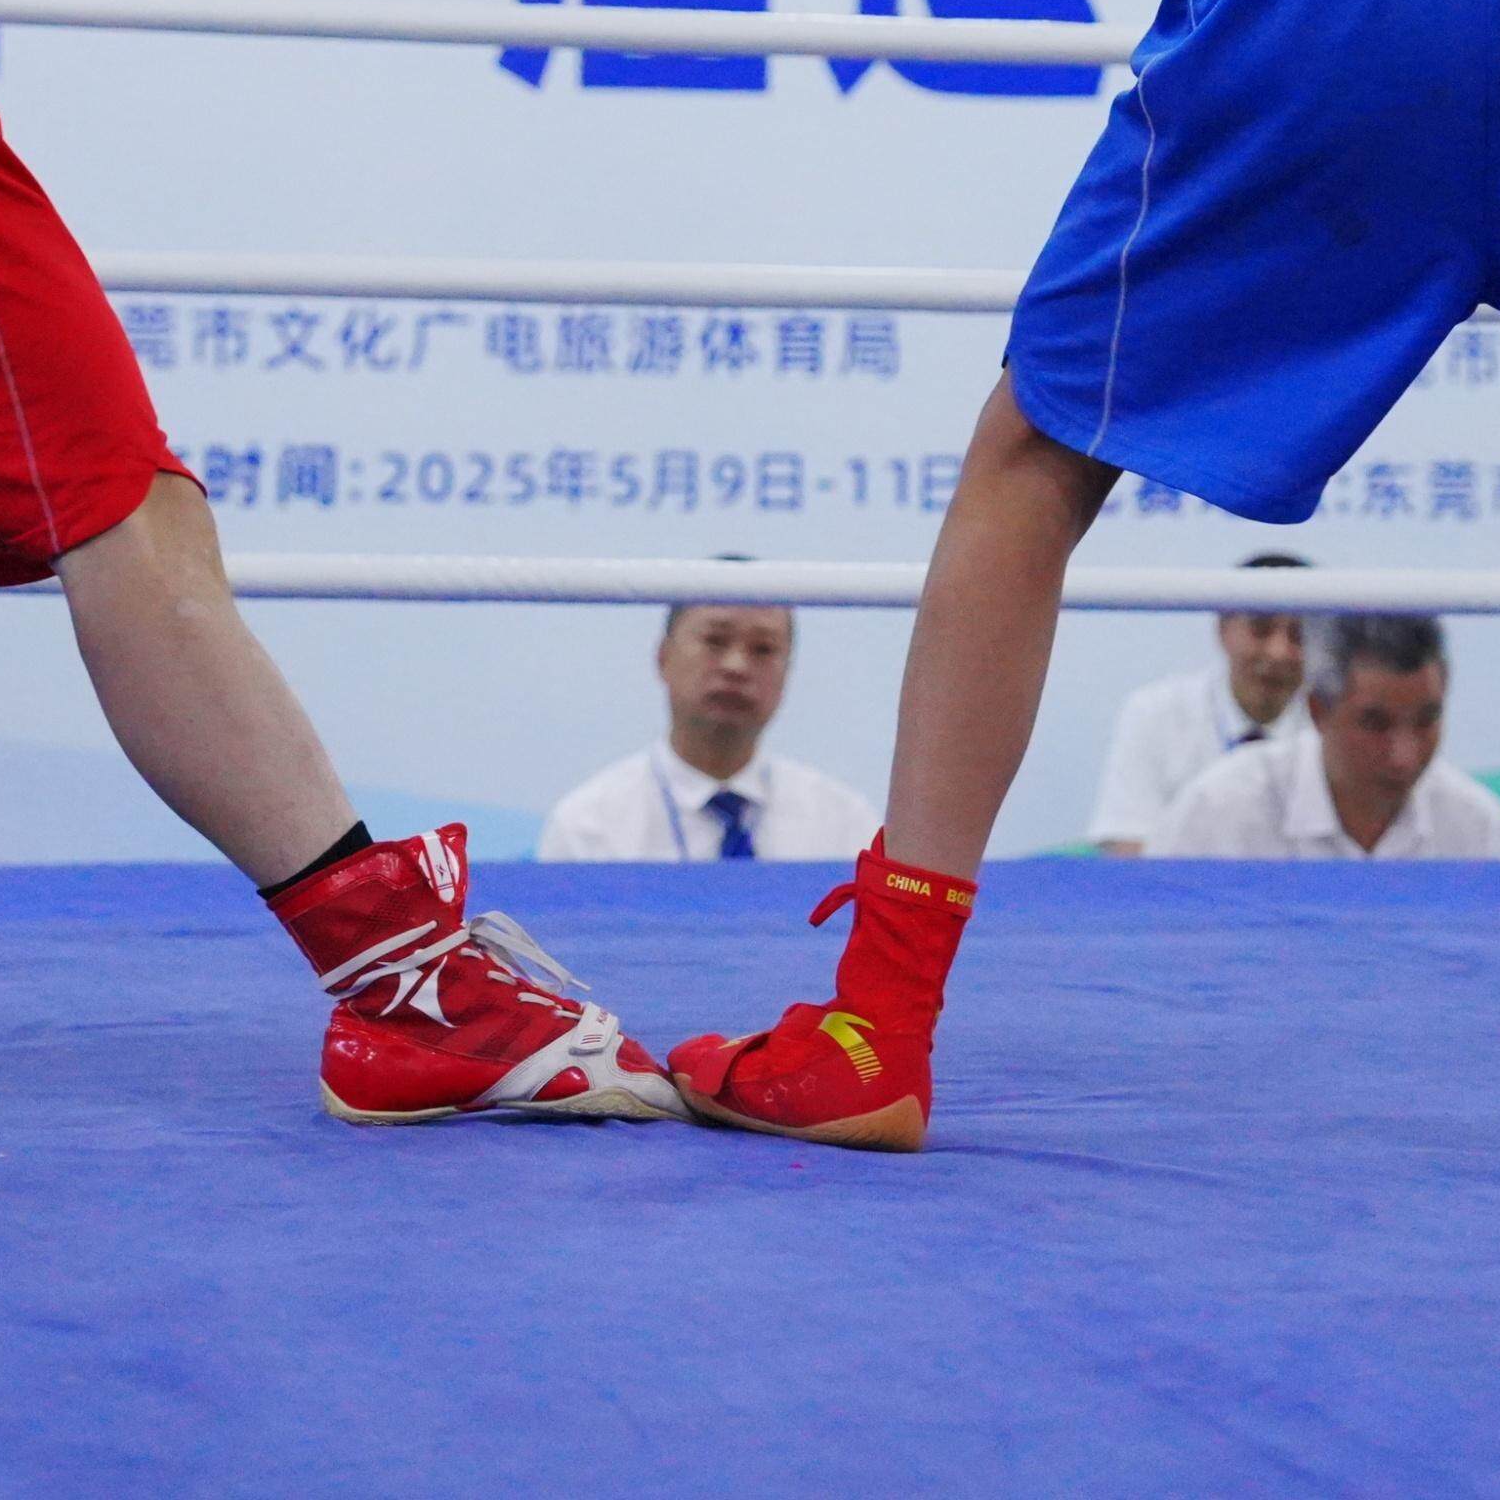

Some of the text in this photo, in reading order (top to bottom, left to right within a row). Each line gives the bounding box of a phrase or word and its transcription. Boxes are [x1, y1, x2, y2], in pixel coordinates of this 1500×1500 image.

[174, 440, 964, 512] 时间:2025年5月9日-11日
[886, 873, 931, 897] CHINA
